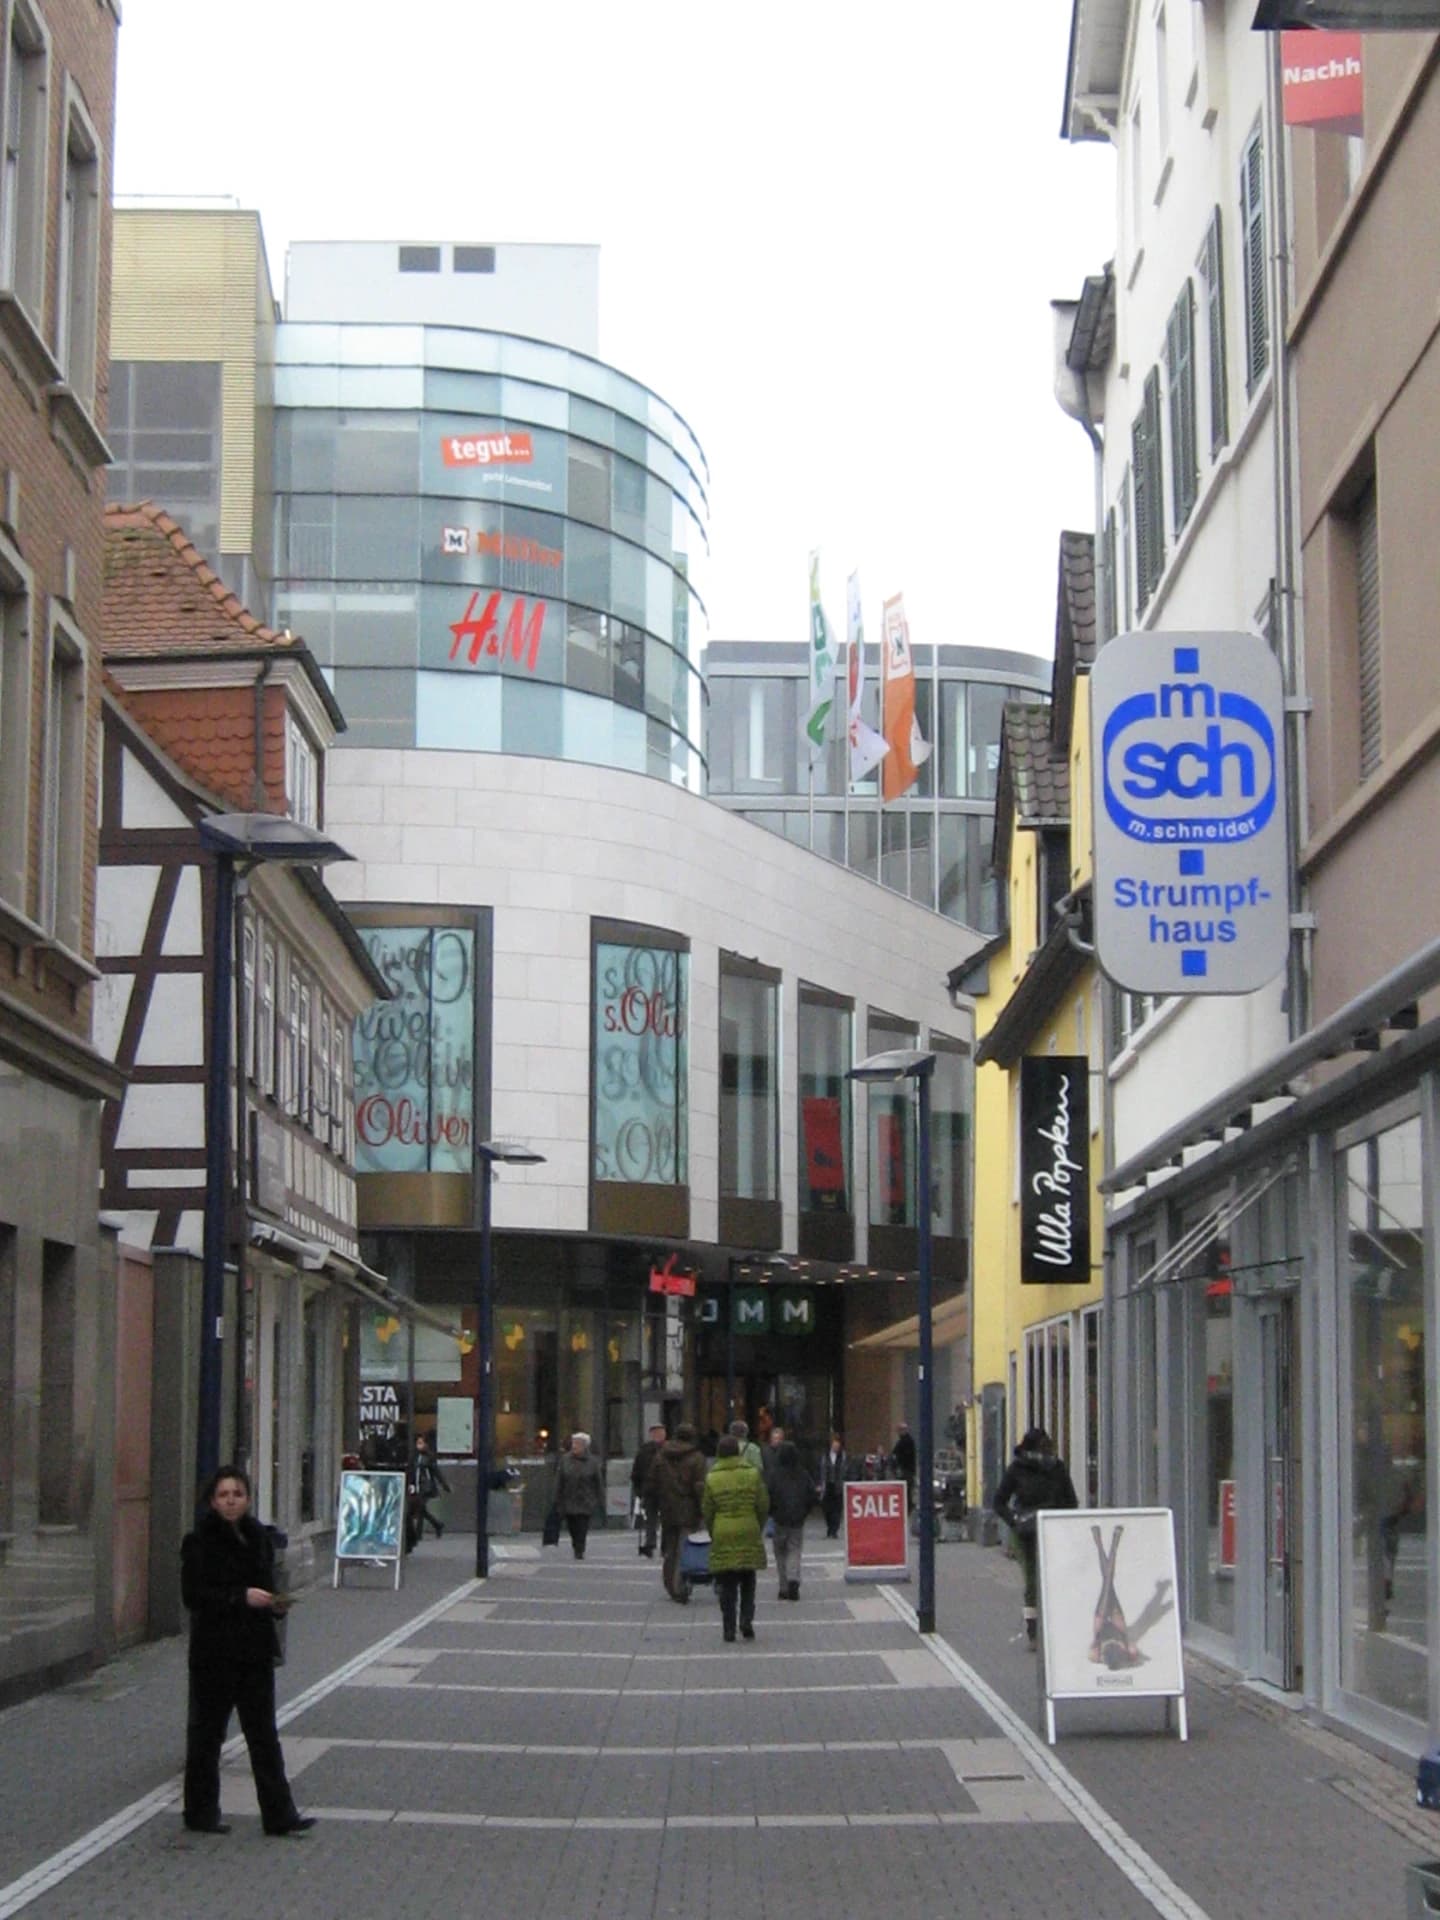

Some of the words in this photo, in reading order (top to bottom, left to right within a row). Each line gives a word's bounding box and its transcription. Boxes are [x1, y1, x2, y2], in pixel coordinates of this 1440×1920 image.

[1283, 57, 1361, 85] Nachh
[448, 591, 546, 672] H&M
[1160, 682, 1215, 718] m
[1123, 725, 1255, 799] sch
[1128, 818, 1257, 840] m.schneider
[1114, 878, 1271, 914] Strumpf-
[1149, 915, 1238, 943] haus
[357, 1094, 469, 1147] Oliver
[1032, 1075, 1083, 1196] Popken
[1033, 1201, 1073, 1266] Ulla
[359, 1385, 397, 1402] STA
[852, 1494, 900, 1518] SALE
